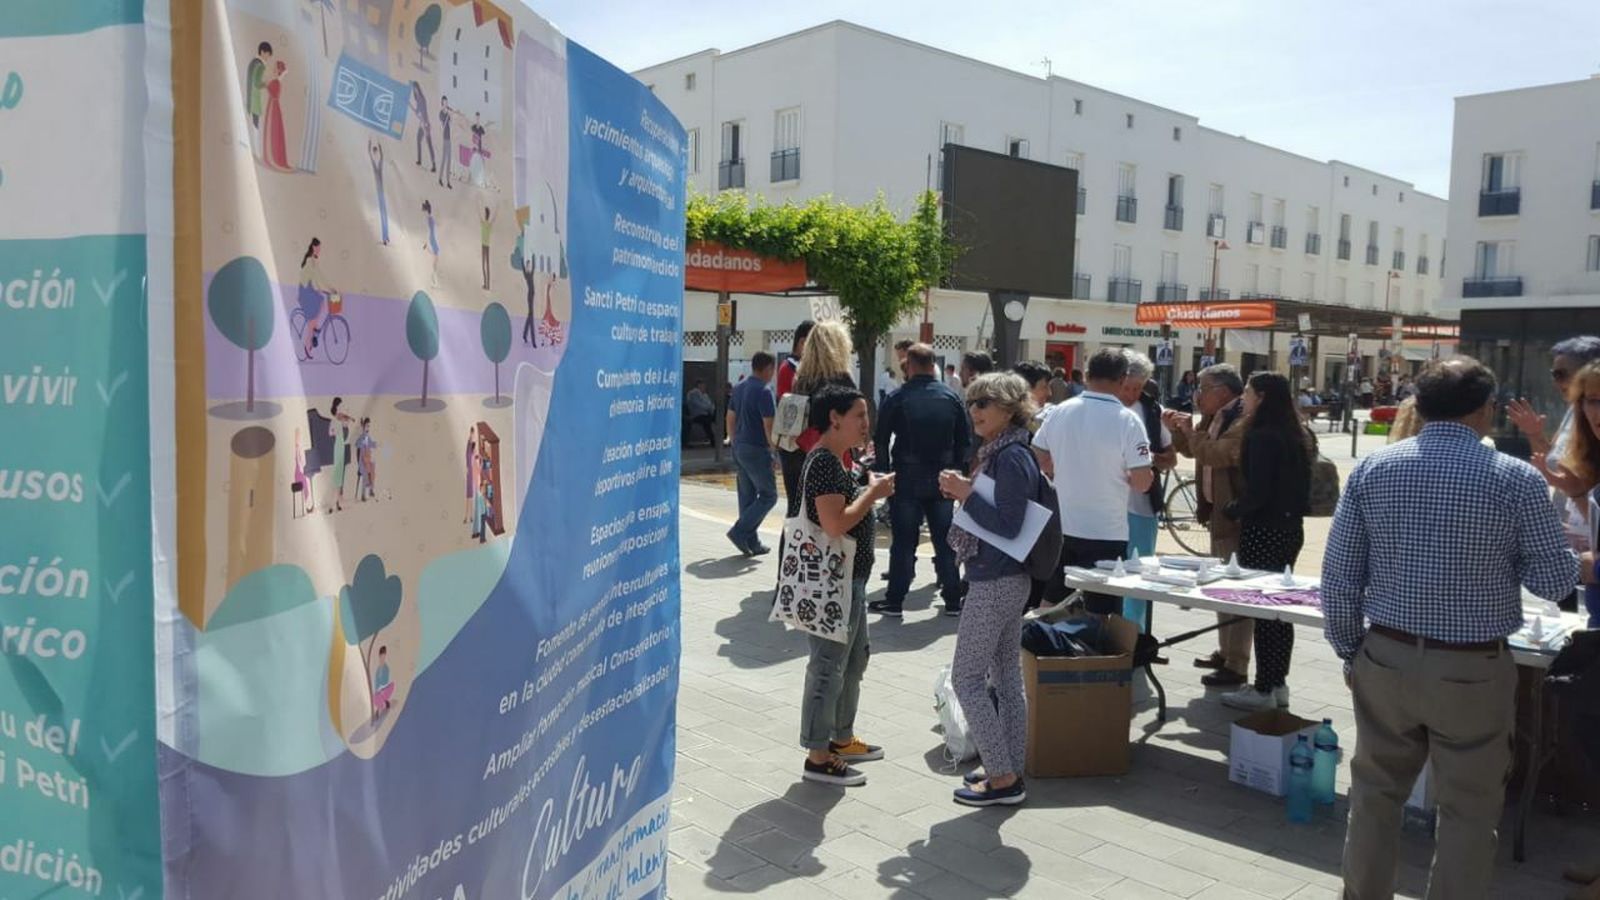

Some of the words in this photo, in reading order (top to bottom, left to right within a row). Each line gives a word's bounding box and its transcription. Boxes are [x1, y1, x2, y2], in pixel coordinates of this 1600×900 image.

[0, 267, 77, 309] ción
[583, 285, 614, 310] Sancti
[2, 365, 79, 406] vivir
[2, 616, 88, 661] rico
[499, 689, 519, 715] en
[521, 679, 535, 704] la
[606, 608, 622, 629] de
[24, 712, 81, 757] del
[16, 757, 90, 810] Petri
